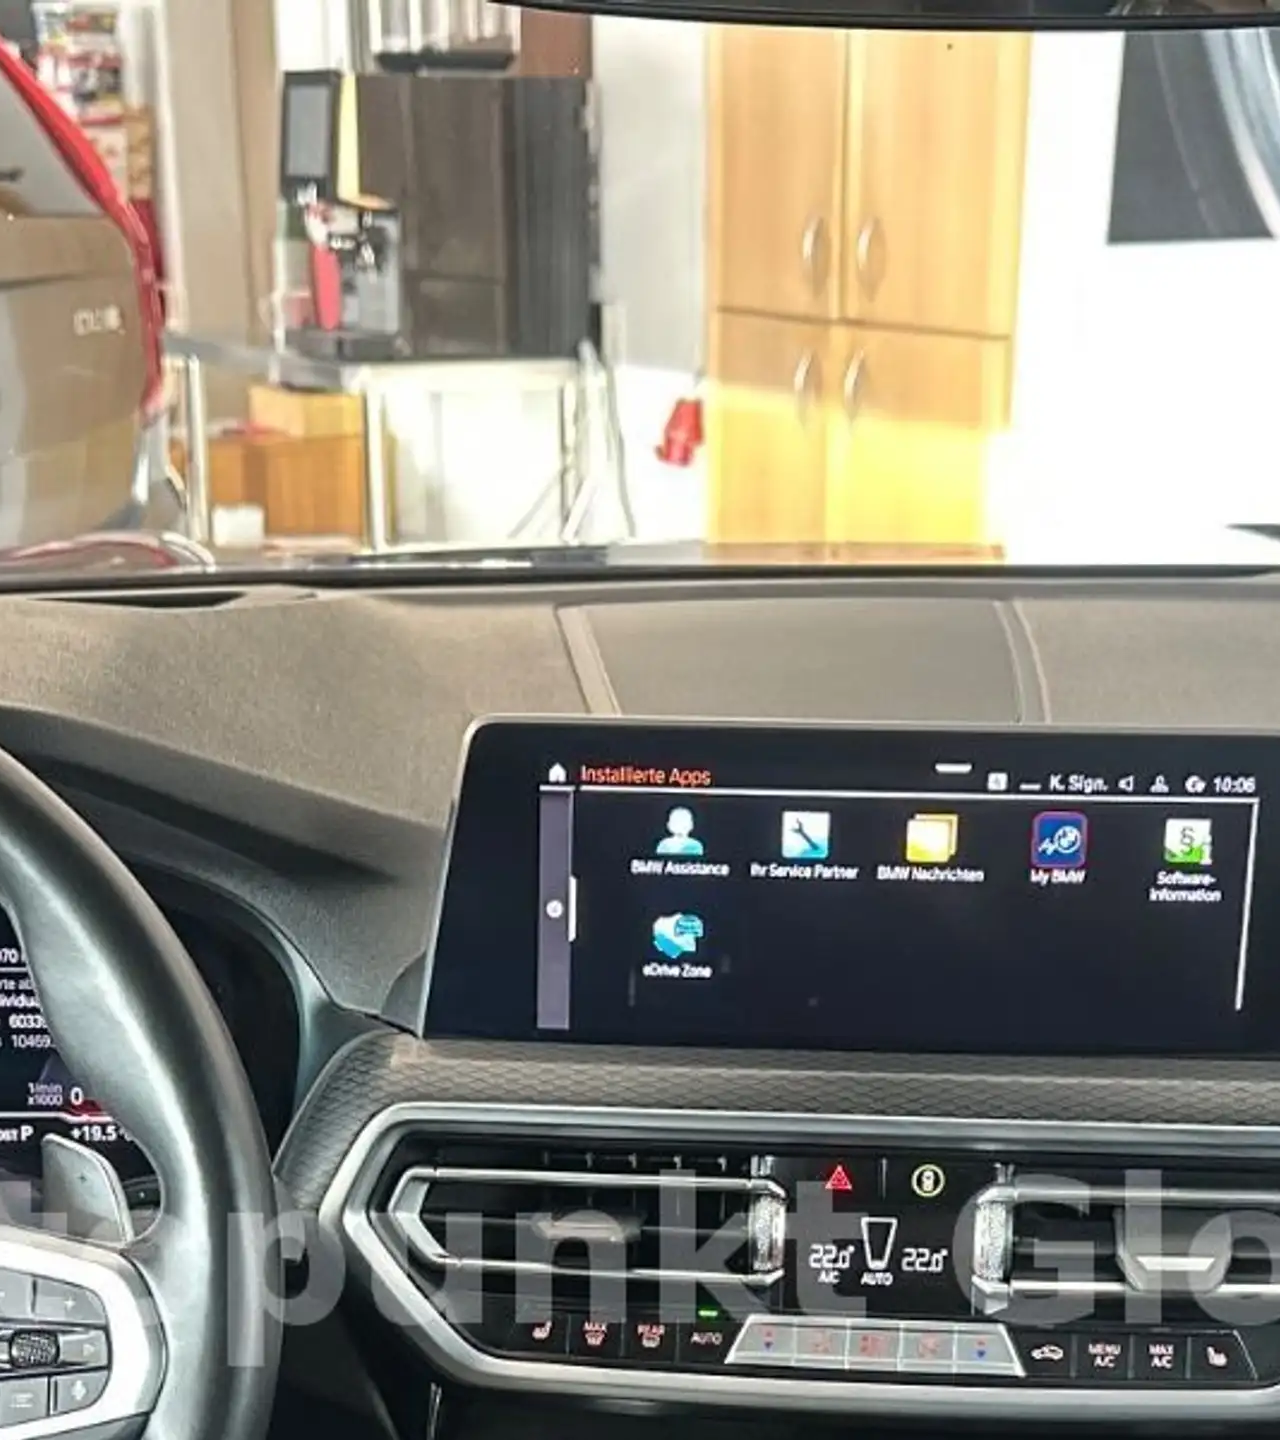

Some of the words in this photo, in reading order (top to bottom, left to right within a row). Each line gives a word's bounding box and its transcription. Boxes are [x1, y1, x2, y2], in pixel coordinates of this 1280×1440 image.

[581, 765, 666, 784] Installierte
[669, 767, 712, 787] Apps
[1068, 774, 1108, 793] Sign.
[631, 860, 663, 875] BMW
[665, 860, 730, 877] Assistance
[770, 864, 812, 879] Service
[815, 865, 859, 880] Partner
[877, 865, 909, 880] BMW
[910, 866, 984, 882] Nachrichten
[1030, 870, 1049, 885] My
[1052, 870, 1085, 884] BMW
[642, 963, 680, 978] eDrive
[682, 963, 713, 979] Zone
[70, 1087, 84, 1105] 0
[21, 1125, 34, 1141] P
[860, 1272, 893, 1286] AUTO
[690, 1331, 723, 1346] AUTO
